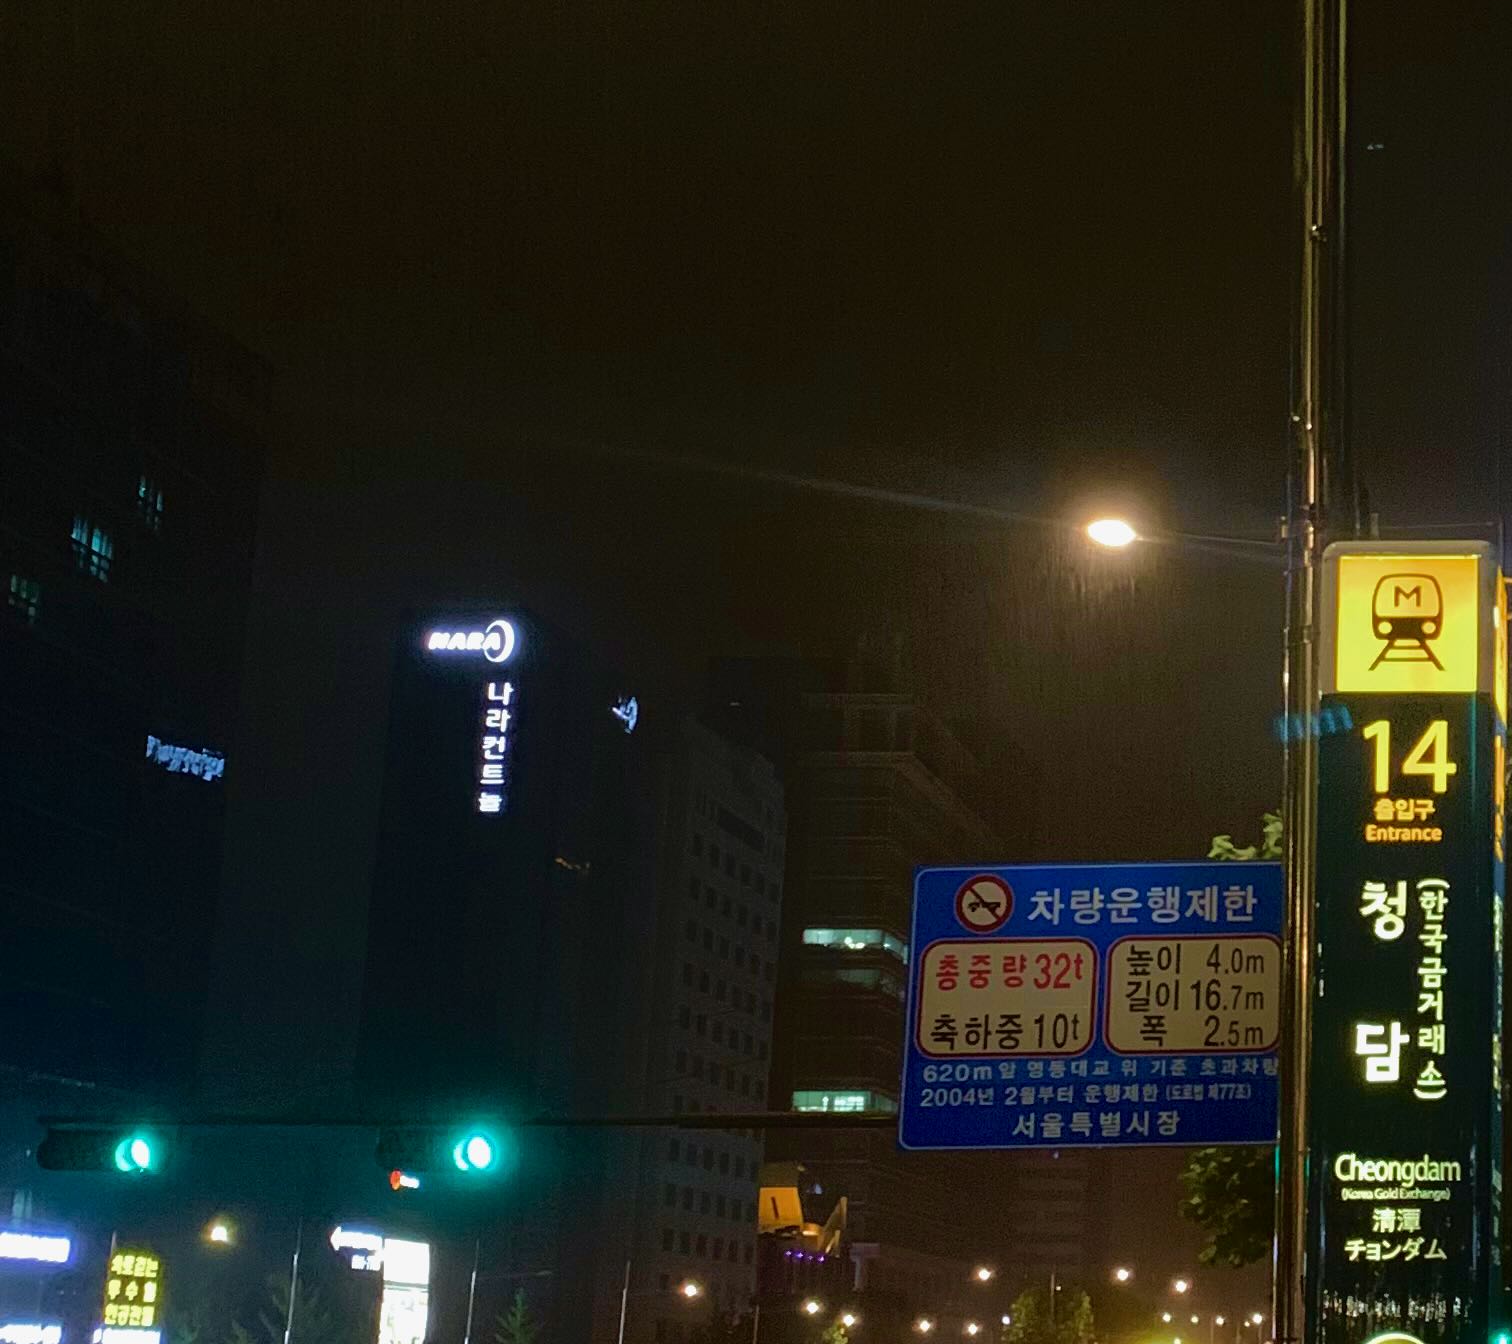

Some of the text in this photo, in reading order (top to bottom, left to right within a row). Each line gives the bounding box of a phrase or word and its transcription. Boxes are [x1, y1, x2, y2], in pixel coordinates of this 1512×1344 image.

[1394, 585, 1421, 607] M
[1363, 720, 1457, 794] 14
[1373, 798, 1436, 822] 출입구
[1365, 824, 1443, 842] Entrance
[1027, 885, 1259, 925] 차량운행제한
[1033, 952, 1085, 990] 32t
[1126, 943, 1265, 977] 높이 4.0m
[1125, 979, 1265, 1012] 길이 16.7m
[1414, 878, 1451, 1100] (한국금거래소)
[930, 1012, 1081, 1051] 축하중 10t
[1139, 1014, 1265, 1048] 폭 2.5m
[922, 1064, 993, 1083] 620m
[998, 1061, 1017, 1080] 앞
[1120, 1059, 1138, 1077] 위
[1150, 1058, 1188, 1077] 기준
[920, 1087, 995, 1107] 2004년
[1004, 1086, 1075, 1106] 2월부터
[1084, 1083, 1159, 1104] 운행제한
[1011, 1110, 1181, 1139] 서울특별시장
[1335, 1153, 1461, 1187] Cheongdam
[1374, 1188, 1400, 1200] Gold
[1344, 1237, 1447, 1261] チョンダム
